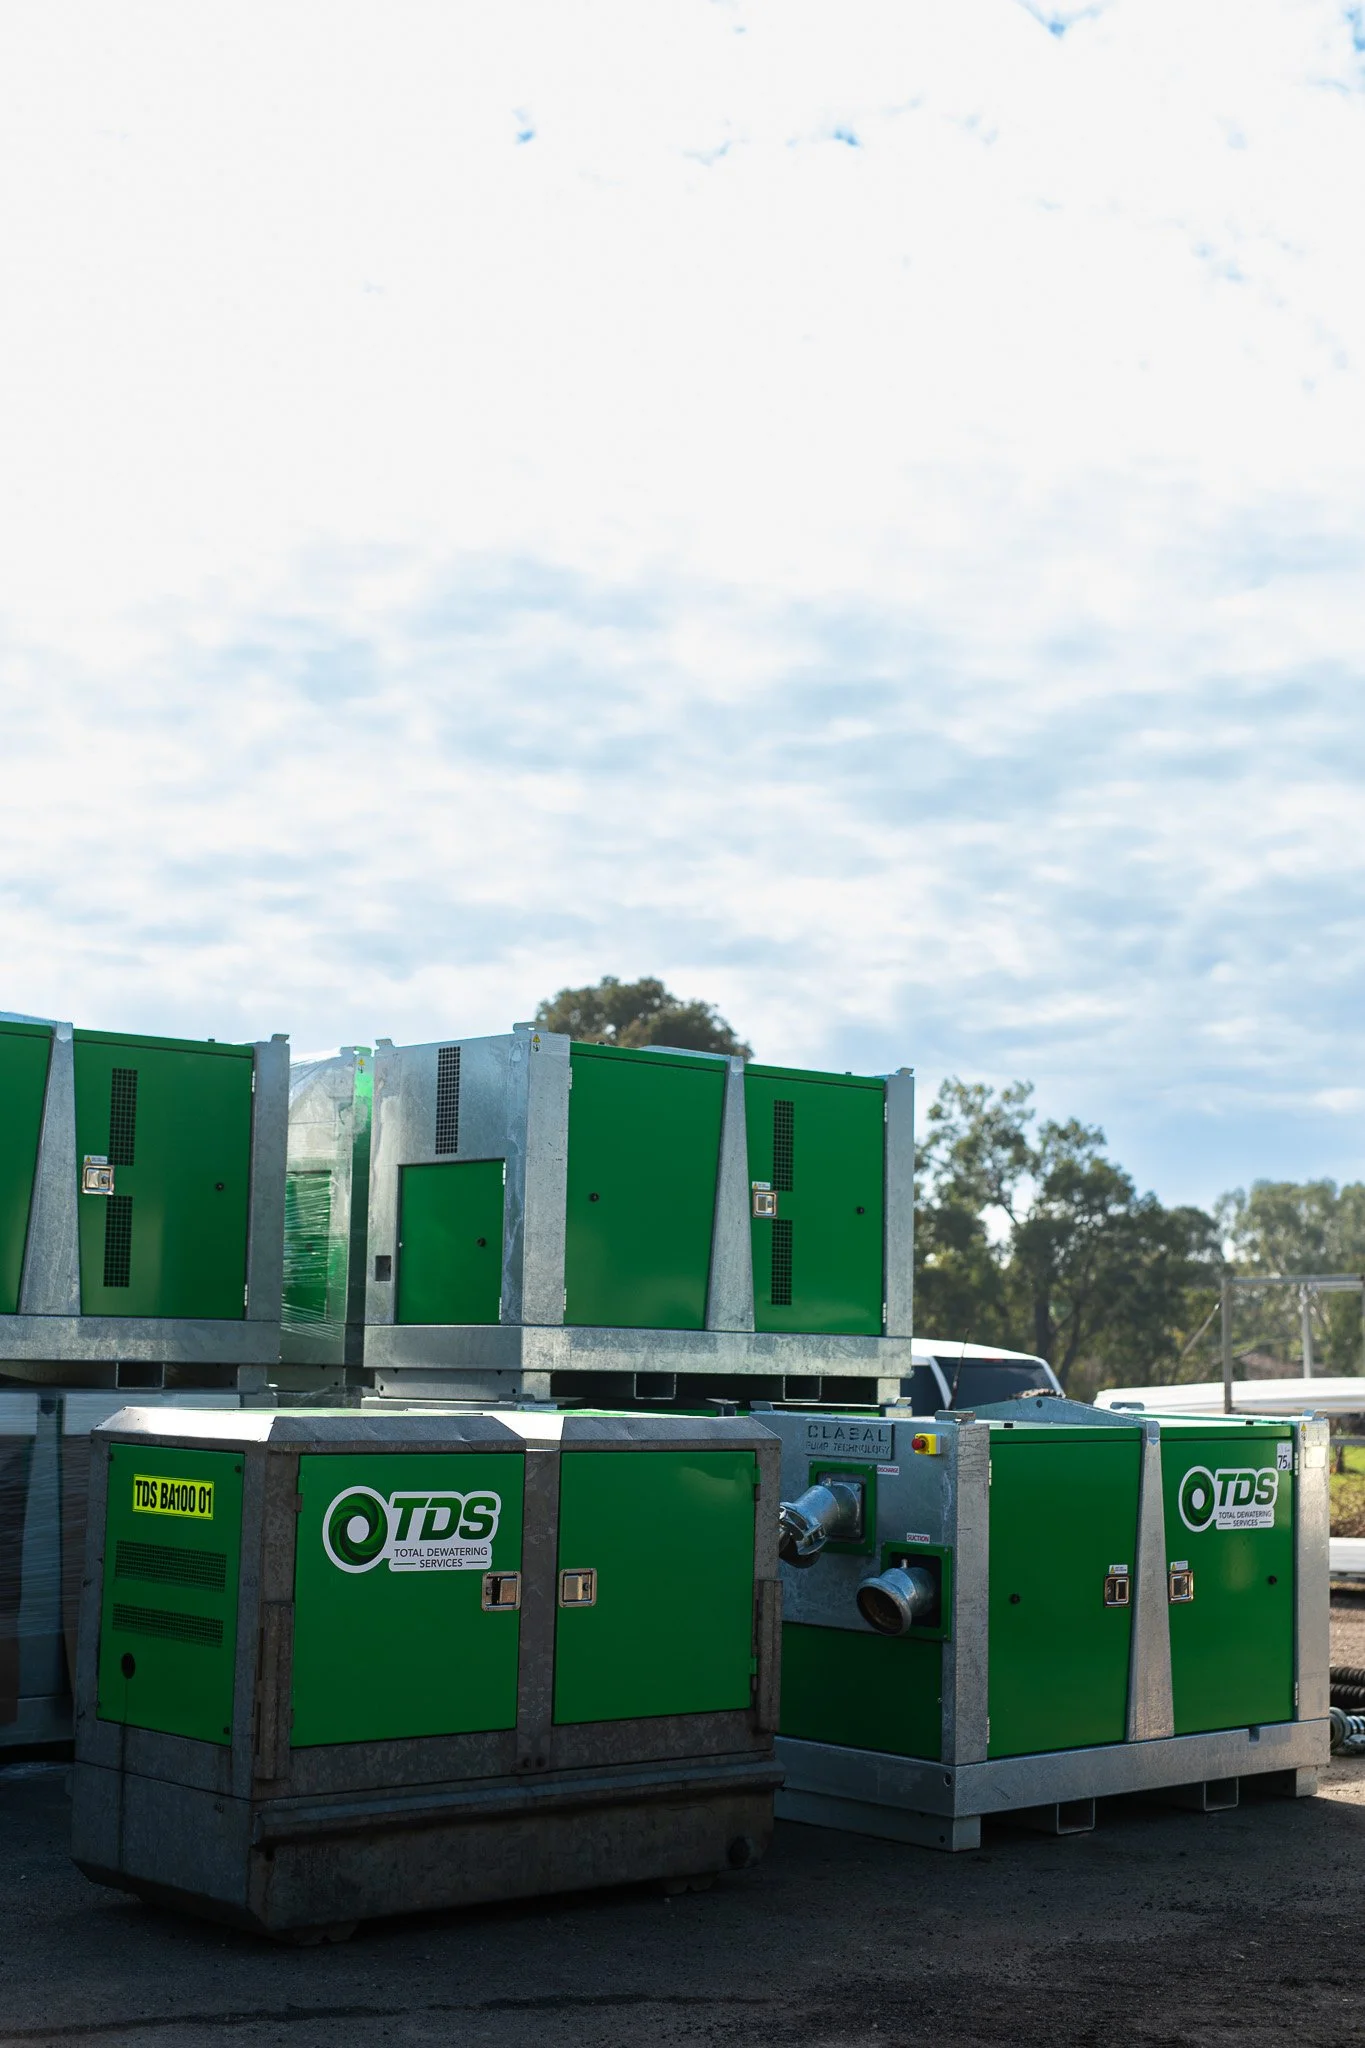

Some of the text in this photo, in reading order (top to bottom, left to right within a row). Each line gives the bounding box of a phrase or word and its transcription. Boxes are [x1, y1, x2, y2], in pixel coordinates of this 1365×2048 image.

[806, 1441, 890, 1454] PUMP TECHNOLOGY
[1278, 1455, 1287, 1468] 75
[1217, 1472, 1276, 1506] TDS
[136, 1480, 211, 1514] TDS BA100 01
[393, 1496, 497, 1541] TDS
[1219, 1510, 1272, 1519] TOTAL DEWATERING
[1233, 1519, 1258, 1527] SERVICES
[907, 1534, 929, 1542] SUCTION
[394, 1547, 488, 1558] TOTAL DEWATERING
[419, 1558, 463, 1568] SERVICES
